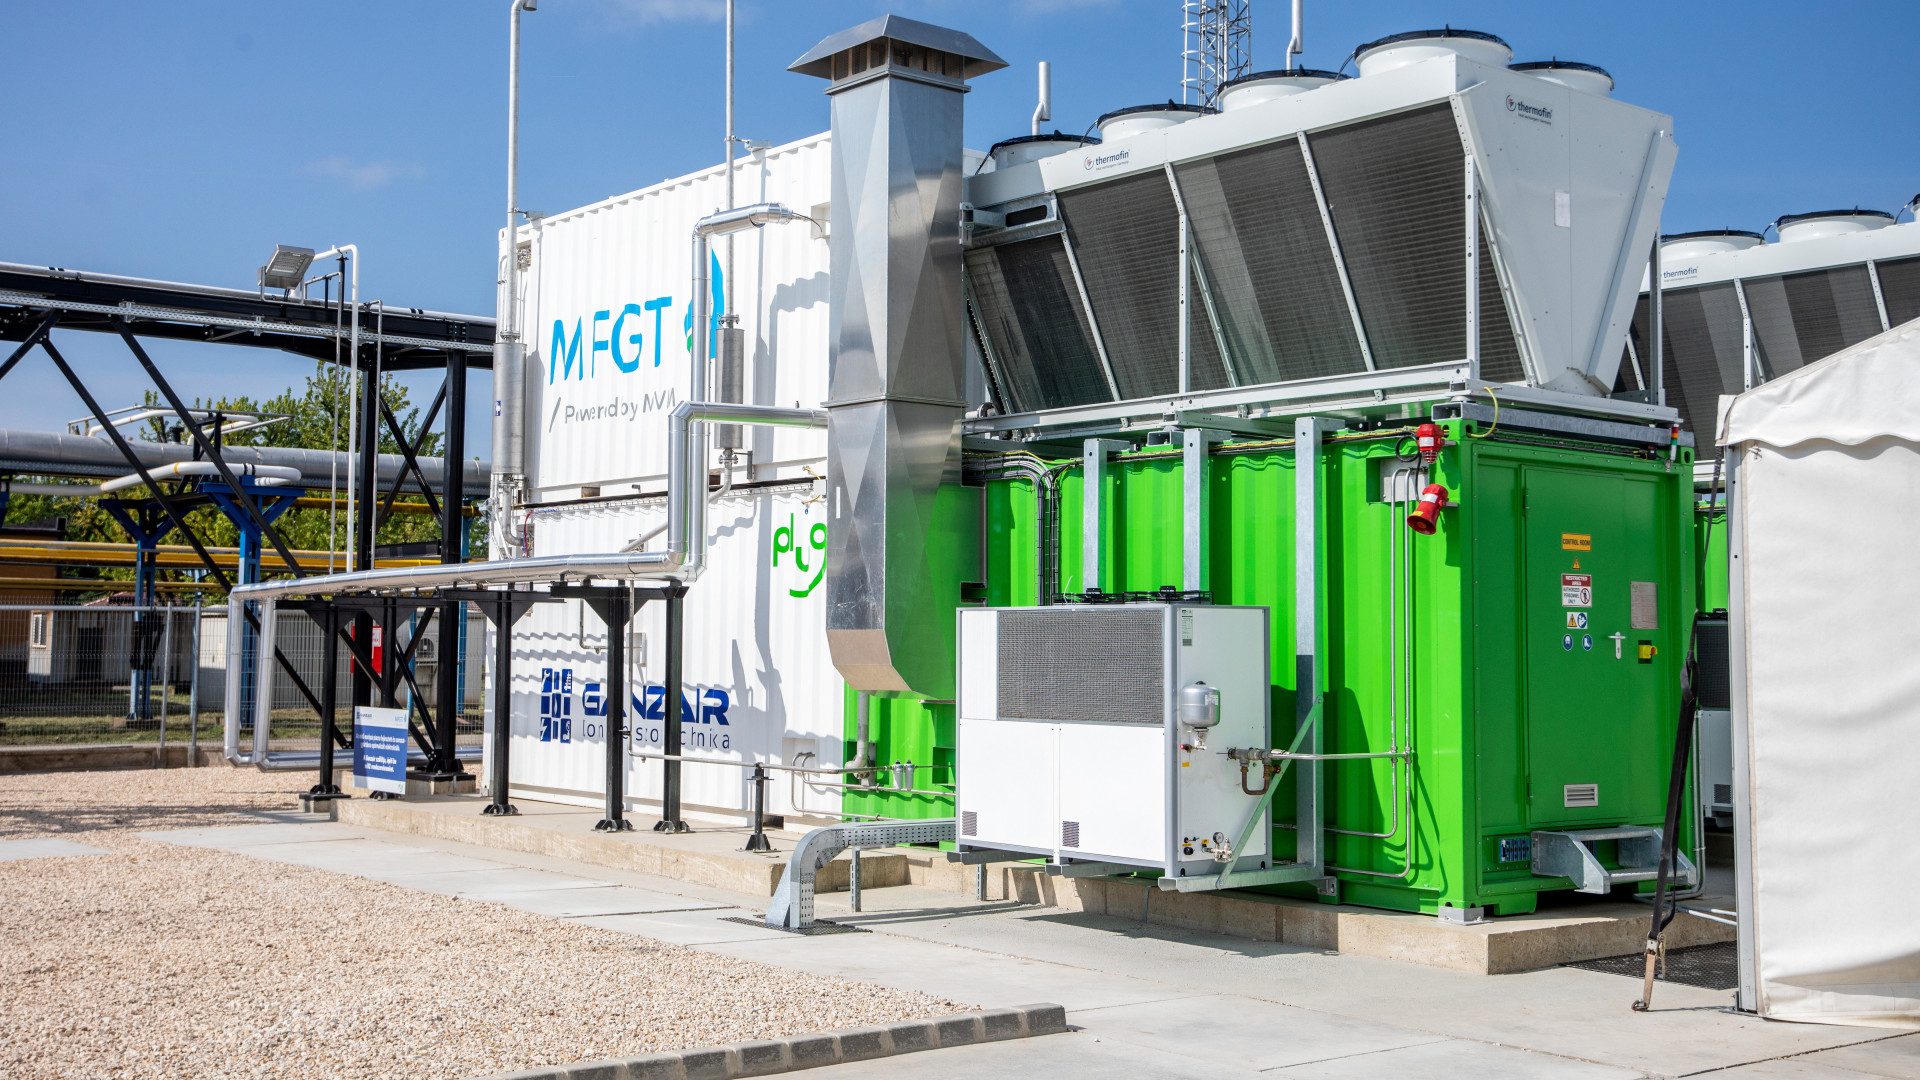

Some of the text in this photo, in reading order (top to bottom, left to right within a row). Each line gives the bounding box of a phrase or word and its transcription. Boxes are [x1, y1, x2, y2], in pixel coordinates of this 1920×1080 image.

[1517, 101, 1552, 119] thermofin
[1095, 150, 1130, 166] thermofin
[1663, 267, 1698, 279] thermofin
[550, 296, 673, 386] MFGT
[564, 396, 619, 424] Pwerd
